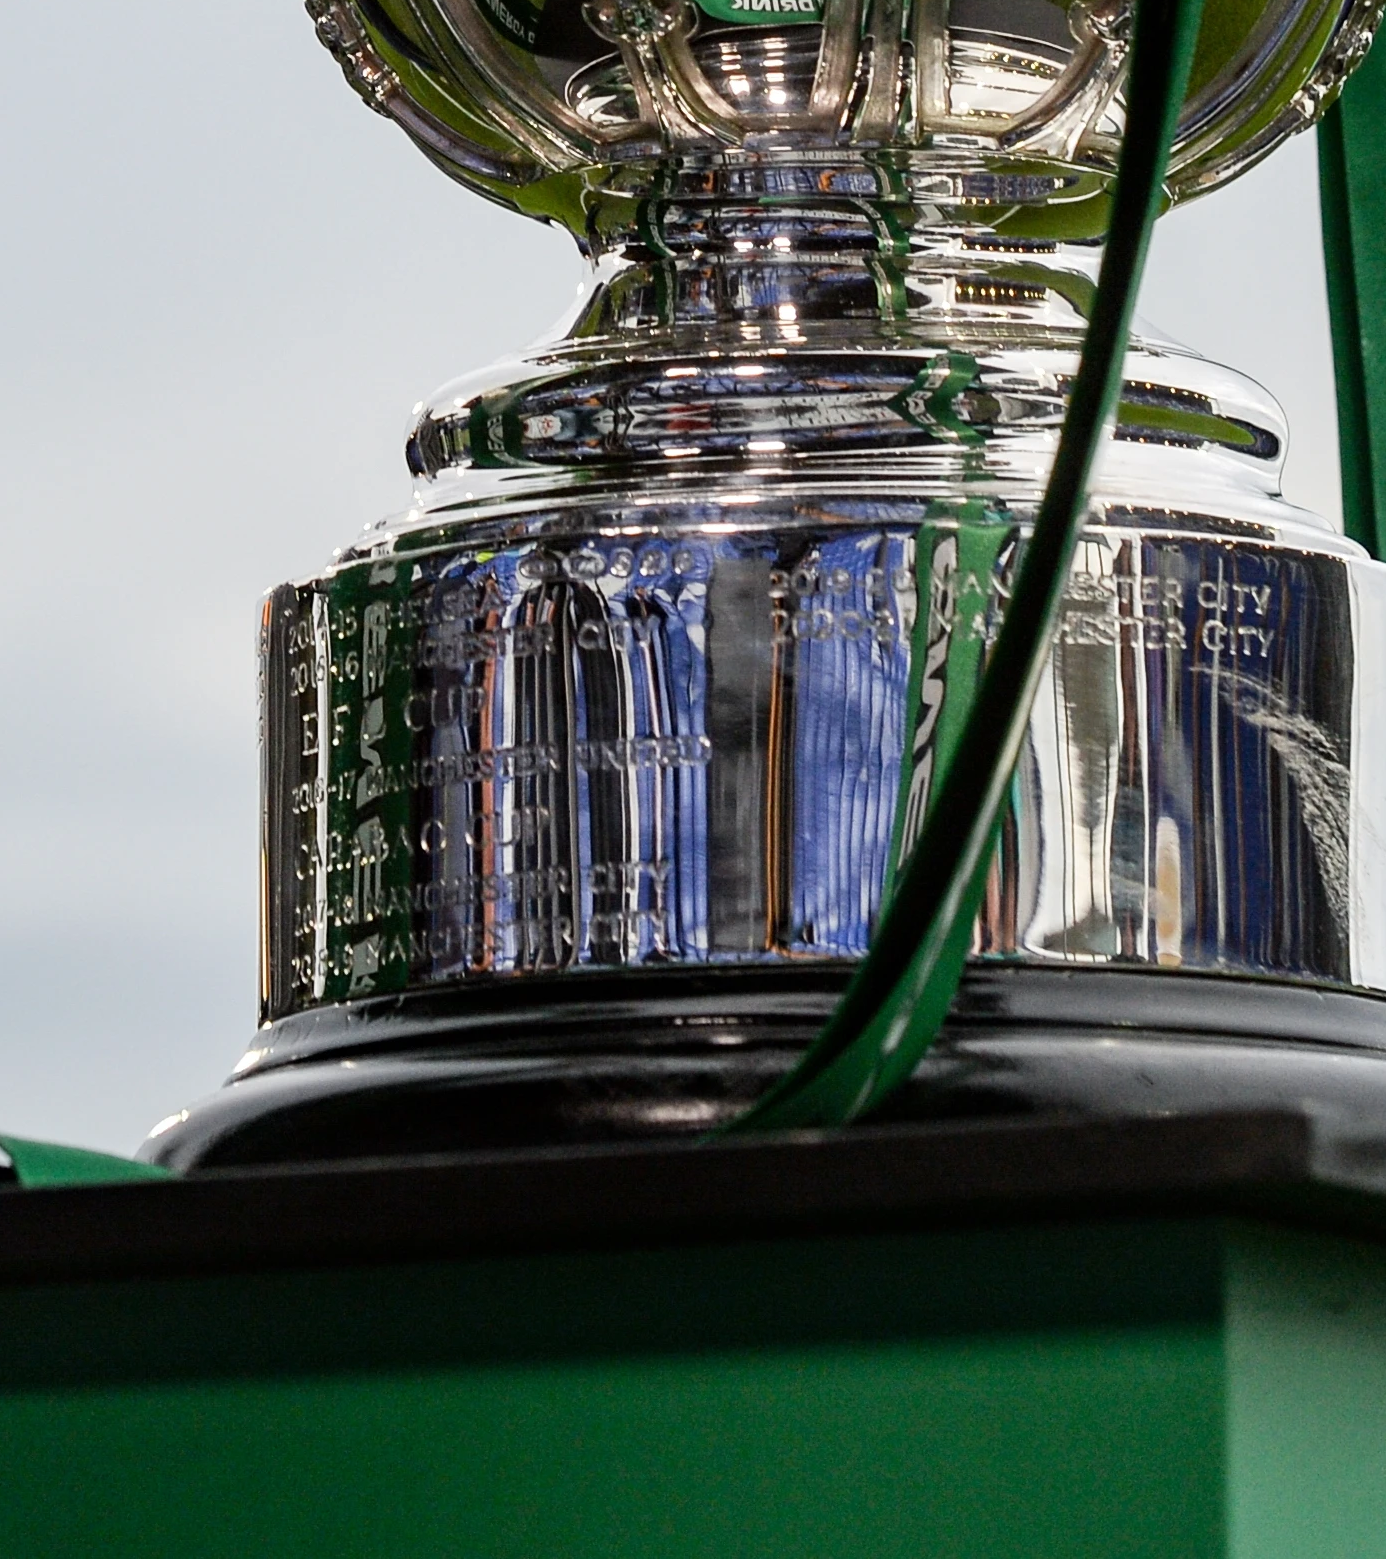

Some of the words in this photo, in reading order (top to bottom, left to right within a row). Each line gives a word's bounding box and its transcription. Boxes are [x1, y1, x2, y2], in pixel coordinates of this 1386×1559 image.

[930, 568, 1184, 609] MANESTER
[1197, 580, 1272, 616] CITY
[929, 609, 1188, 650] MANESTER
[1202, 619, 1275, 658] CITY
[403, 684, 485, 732] CUP
